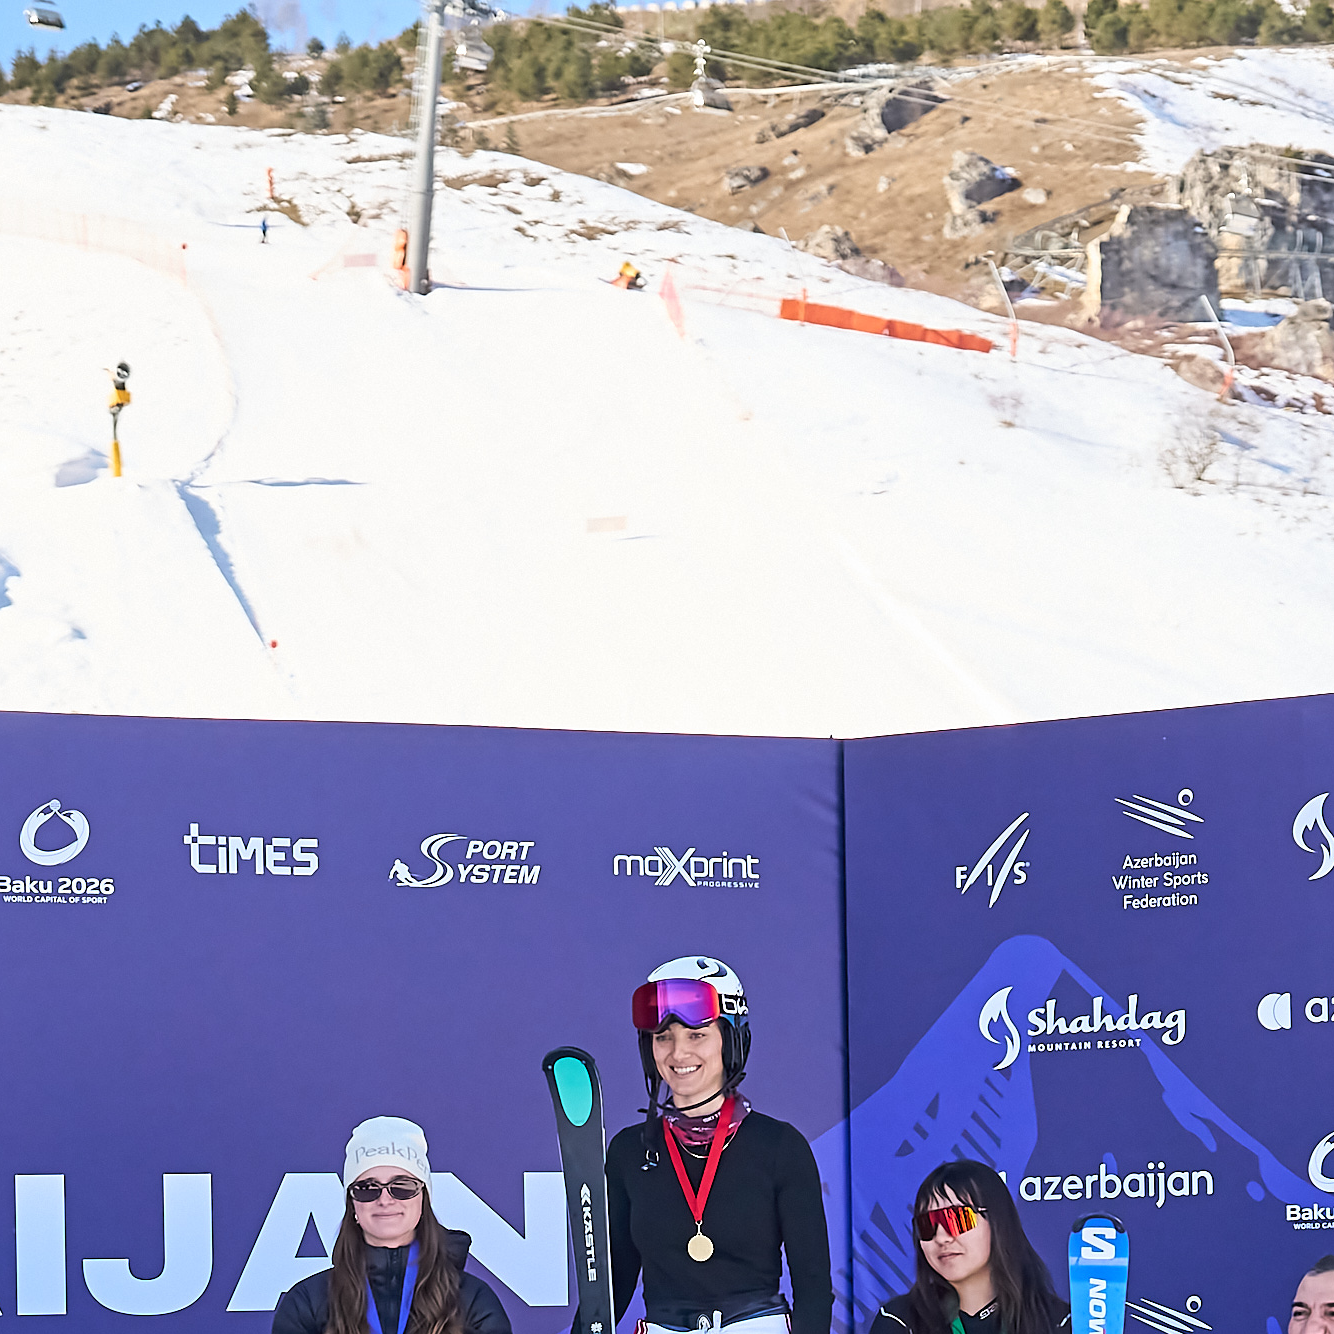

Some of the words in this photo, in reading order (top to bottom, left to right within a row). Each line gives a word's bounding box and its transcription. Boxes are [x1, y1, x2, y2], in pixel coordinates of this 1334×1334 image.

[1122, 851, 1197, 870] Azerbaijan
[58, 877, 115, 895] 2026
[696, 880, 760, 889] PROGRESSIVE
[1111, 875, 1160, 890] Winter
[1163, 871, 1209, 889] Sports
[3, 895, 33, 904] WORLD
[34, 896, 68, 904] CAPITAL
[82, 896, 108, 904] SPORT
[1123, 892, 1198, 910] Federation
[1026, 993, 1188, 1046] Shahdag
[1027, 1041, 1091, 1053] MOUNTAIN
[1096, 1038, 1142, 1049] RESORT
[1019, 1161, 1214, 1209] azerbaijan
[1293, 1222, 1321, 1230] WORLD
